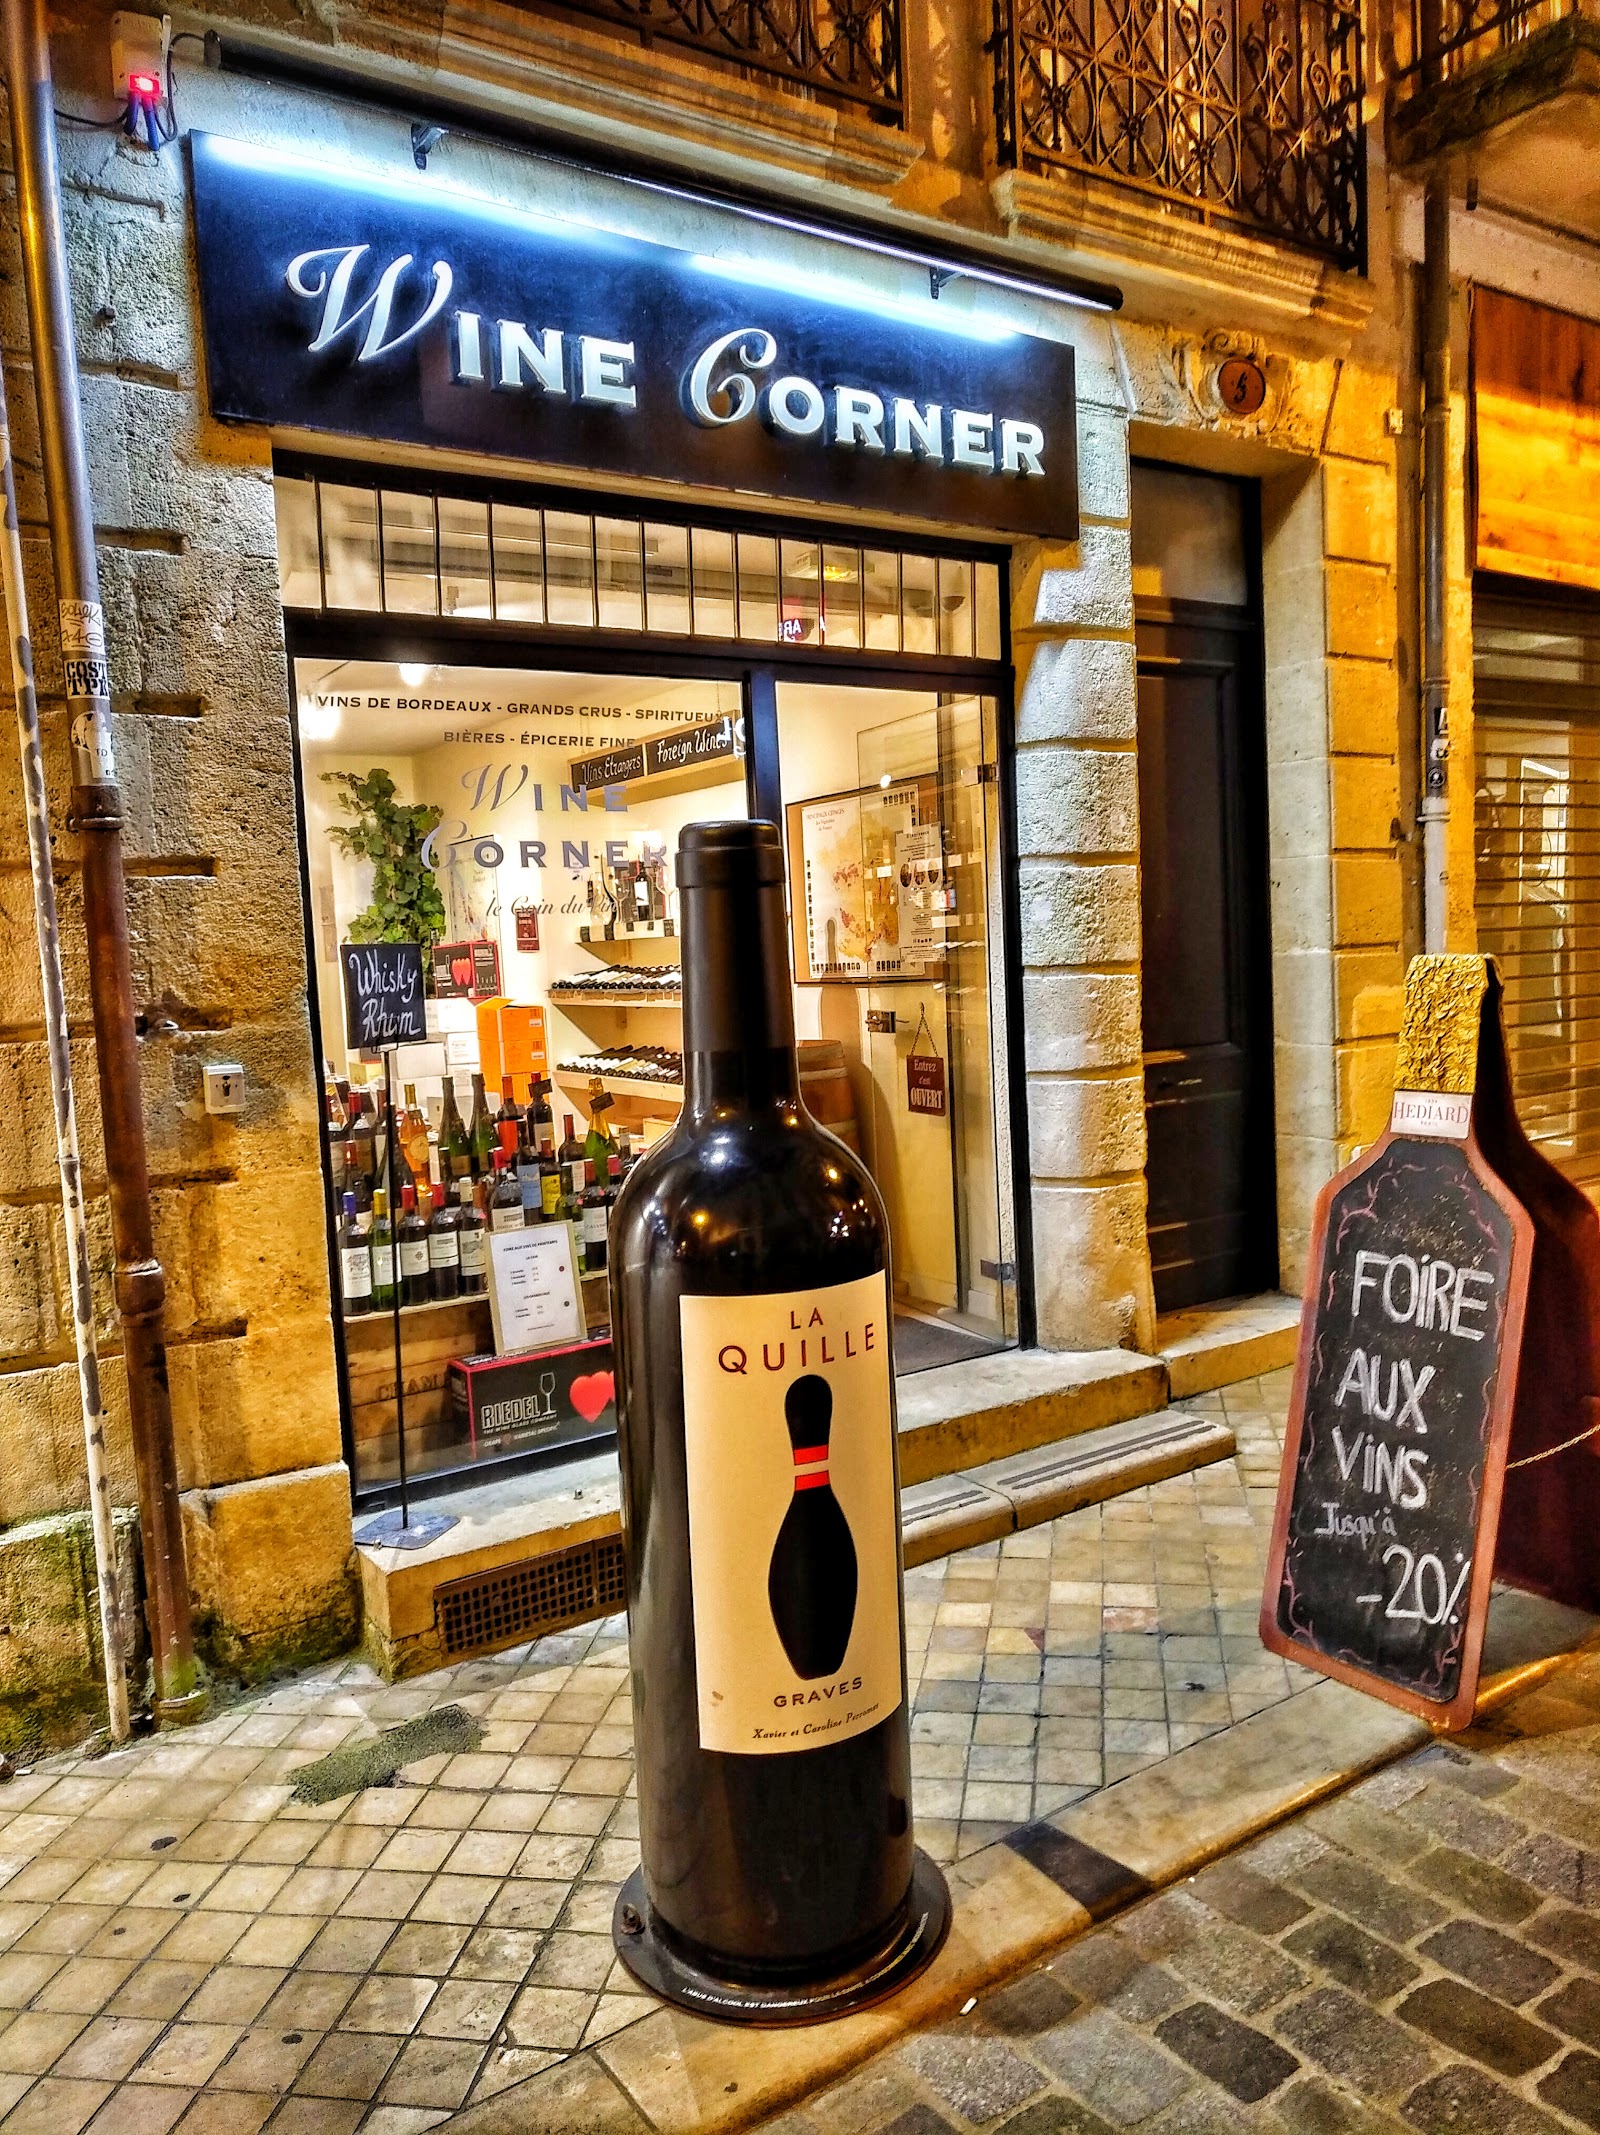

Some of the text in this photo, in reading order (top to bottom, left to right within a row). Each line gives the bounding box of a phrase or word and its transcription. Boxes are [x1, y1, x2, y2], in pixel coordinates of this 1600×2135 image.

[285, 243, 1047, 477] WINE CORNER
[317, 695, 362, 708] VINS
[367, 697, 391, 709] DE
[397, 698, 492, 713] BORDEAUX
[507, 702, 574, 716] GRANDS
[578, 705, 622, 718] CRUS
[635, 708, 724, 724] SPIRITUEUX
[443, 729, 505, 744] BIÈRES
[520, 731, 594, 747] ÉPICERIE
[599, 736, 636, 749] FINE
[657, 739, 693, 763] Foreign
[460, 763, 629, 813] WINE
[581, 762, 603, 786] Vins
[421, 819, 668, 871] CORNER
[485, 895, 501, 917] le
[510, 895, 558, 917] Coin
[561, 894, 585, 915] du
[348, 948, 418, 1004] Whisky
[362, 996, 421, 1041] Rhum
[914, 1059, 937, 1073] Entrez
[910, 1086, 944, 1109] OUVERT
[1393, 1101, 1469, 1124] HEDIARD
[790, 1307, 824, 1331] LA
[718, 1322, 875, 1375] QUILLE
[1334, 1348, 1437, 1435] AUX
[481, 1394, 541, 1430] RIEDEL
[773, 1676, 863, 1708] GRAVES
[752, 1728, 787, 1739] Xavier
[790, 1729, 799, 1737] et
[803, 1718, 842, 1735] Caroline
